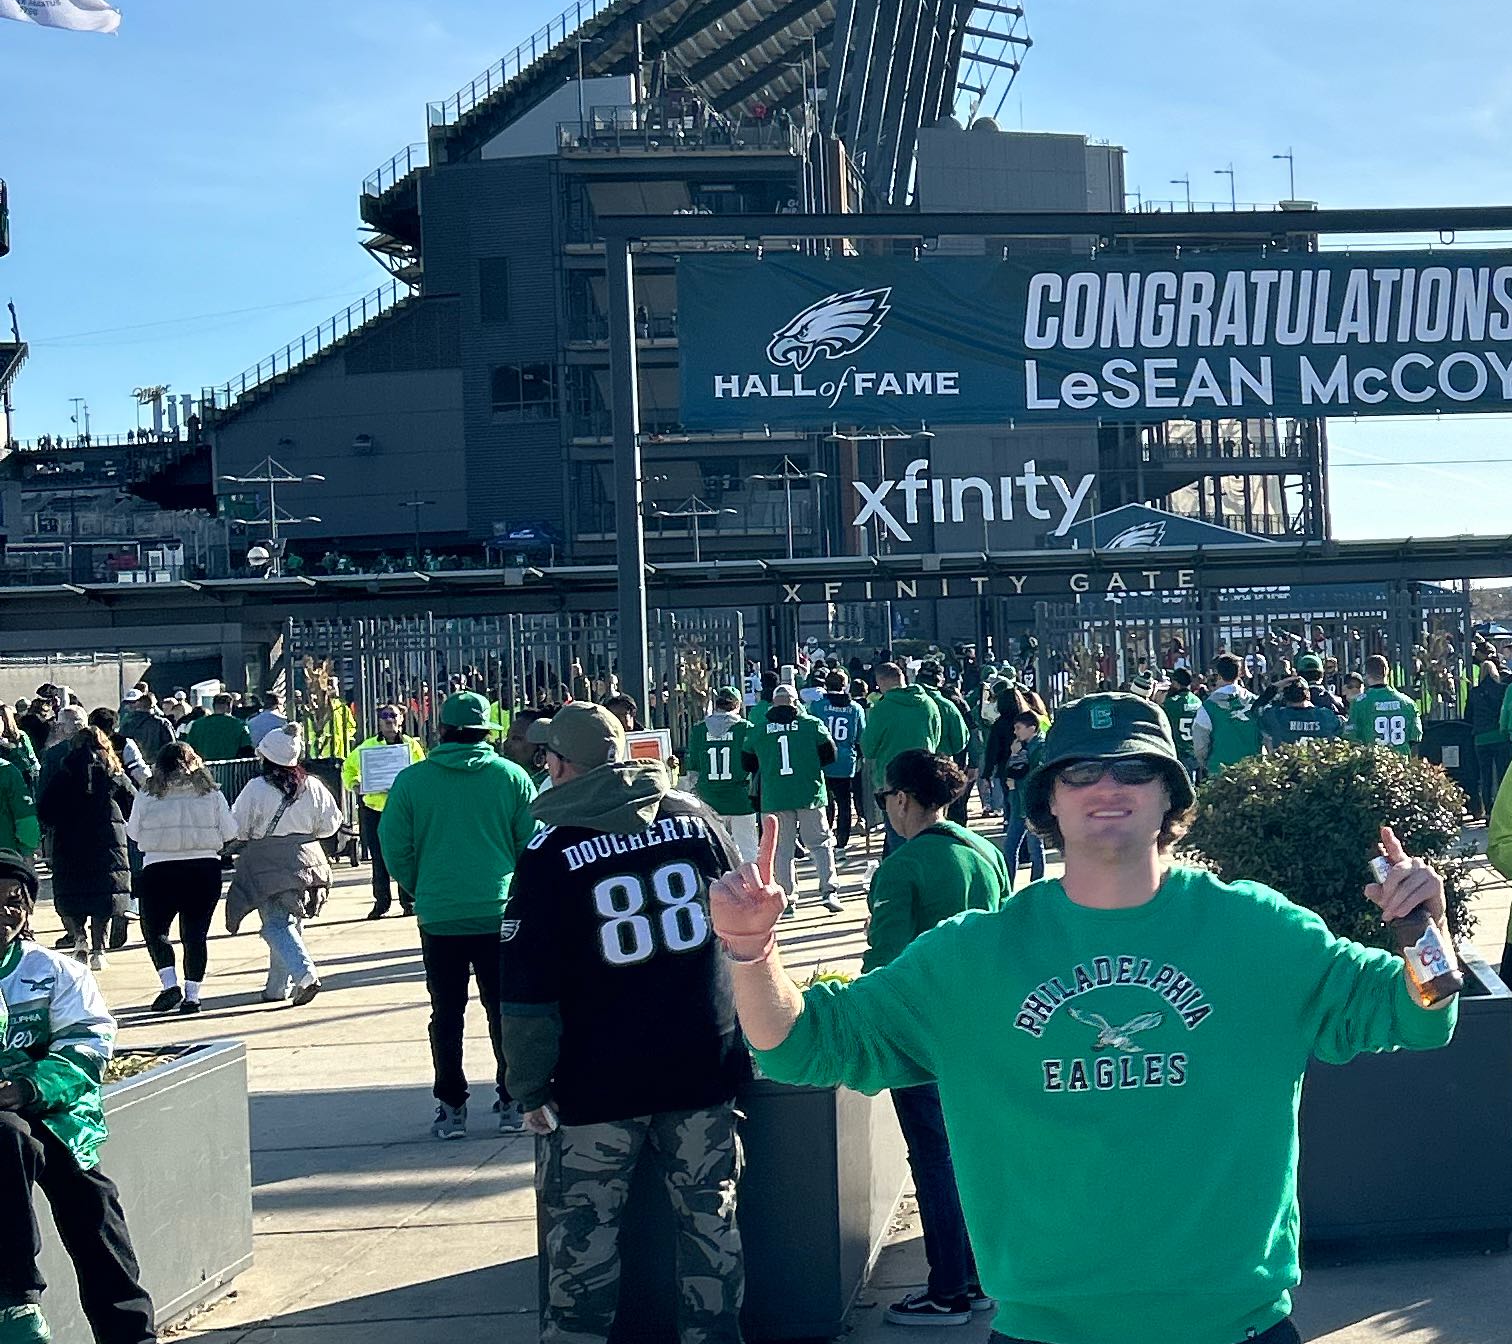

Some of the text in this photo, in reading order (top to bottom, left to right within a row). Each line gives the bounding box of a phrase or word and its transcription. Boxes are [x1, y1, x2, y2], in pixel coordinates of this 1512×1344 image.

[714, 366, 960, 408] HALL of FAME
[1025, 356, 1273, 410] LeSEAN
[852, 459, 1095, 542] xfinity
[783, 570, 1195, 602] XFINITY GATE
[827, 716, 848, 741] 16
[1289, 721, 1321, 731] HURTS
[1374, 716, 1406, 746] 98
[707, 746, 733, 781] 11
[777, 735, 794, 776] 1
[562, 815, 709, 872] DOUGHERTY
[593, 862, 708, 965] 88
[1013, 954, 1214, 1039] PHILADELPHIA
[1041, 1052, 1188, 1093] EAGLES
